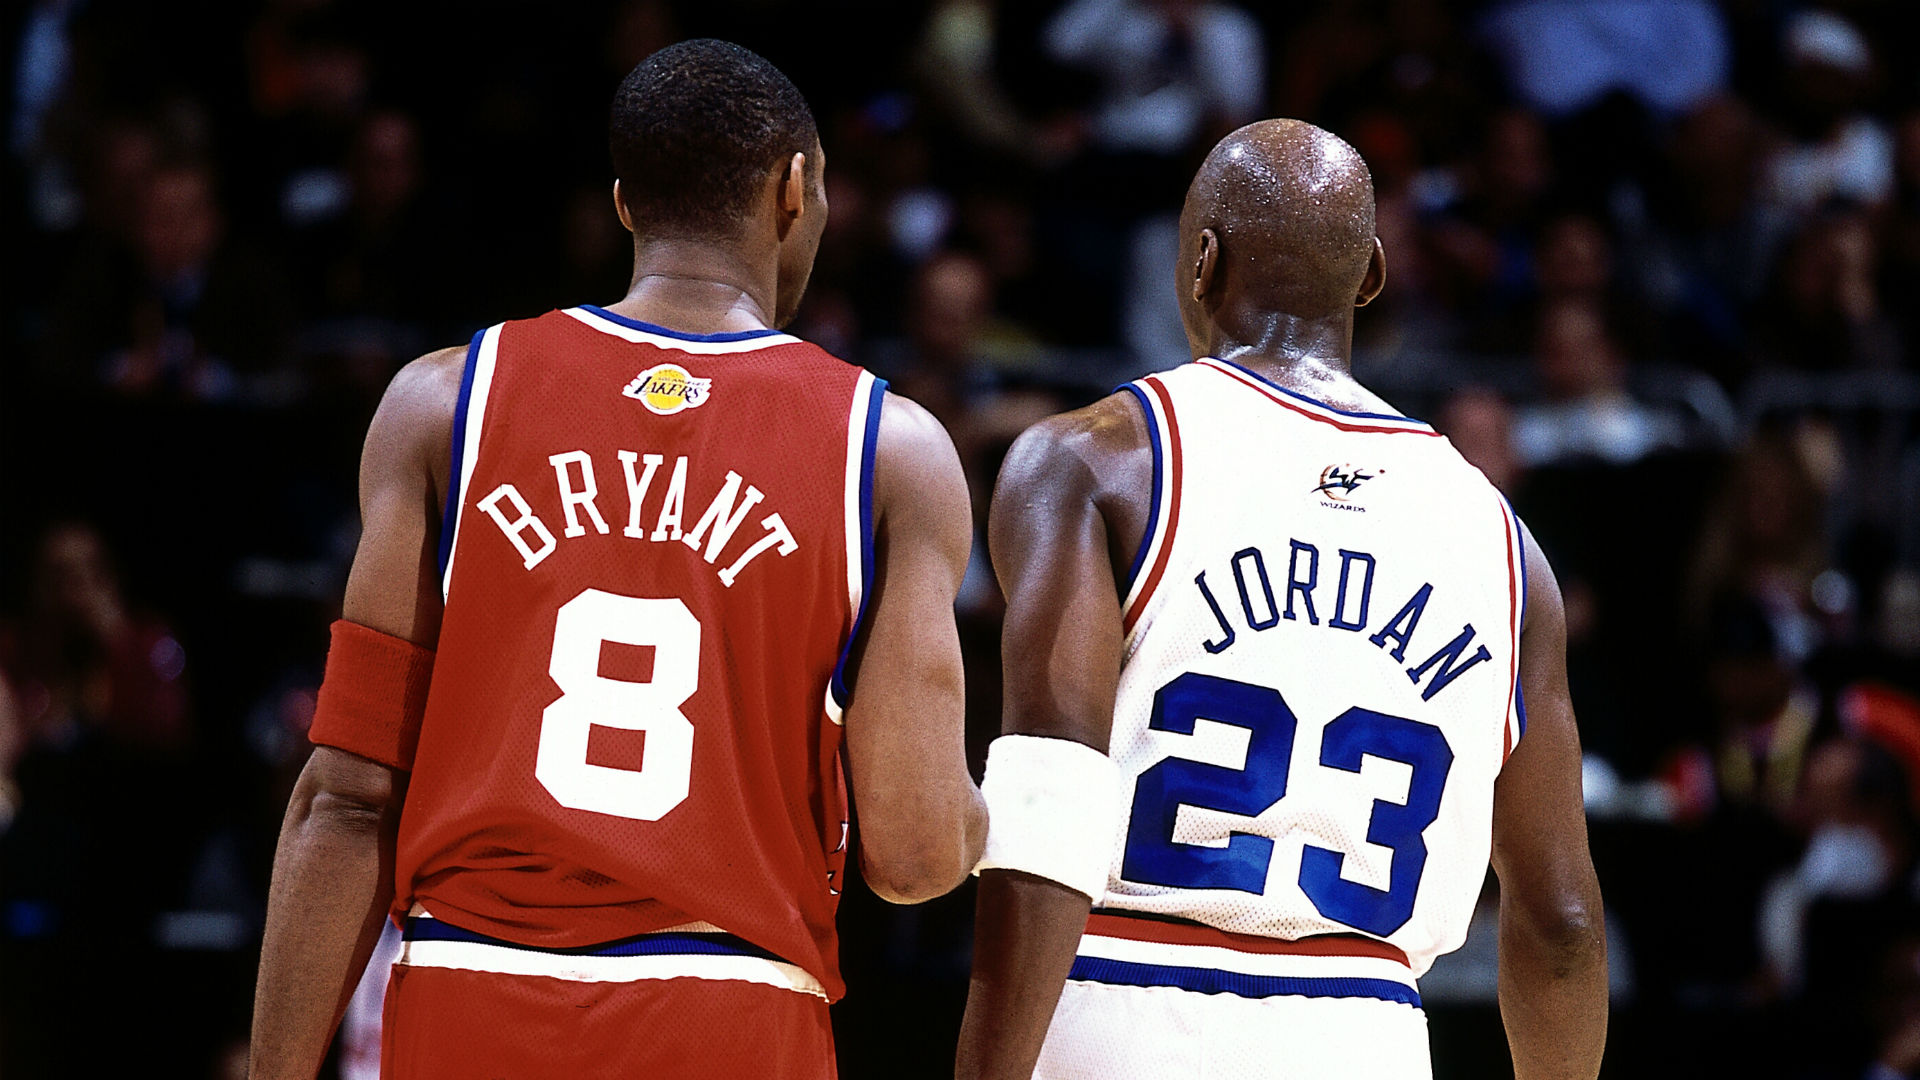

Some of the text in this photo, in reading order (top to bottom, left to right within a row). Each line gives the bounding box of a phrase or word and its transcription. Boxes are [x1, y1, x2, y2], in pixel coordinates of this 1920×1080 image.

[634, 376, 703, 404] LAKERS
[477, 450, 799, 588] BRYANT
[1320, 501, 1366, 513] WIZARDS
[1195, 538, 1493, 702] JORDAN
[535, 588, 702, 822] 8
[1121, 671, 1455, 938] 23
